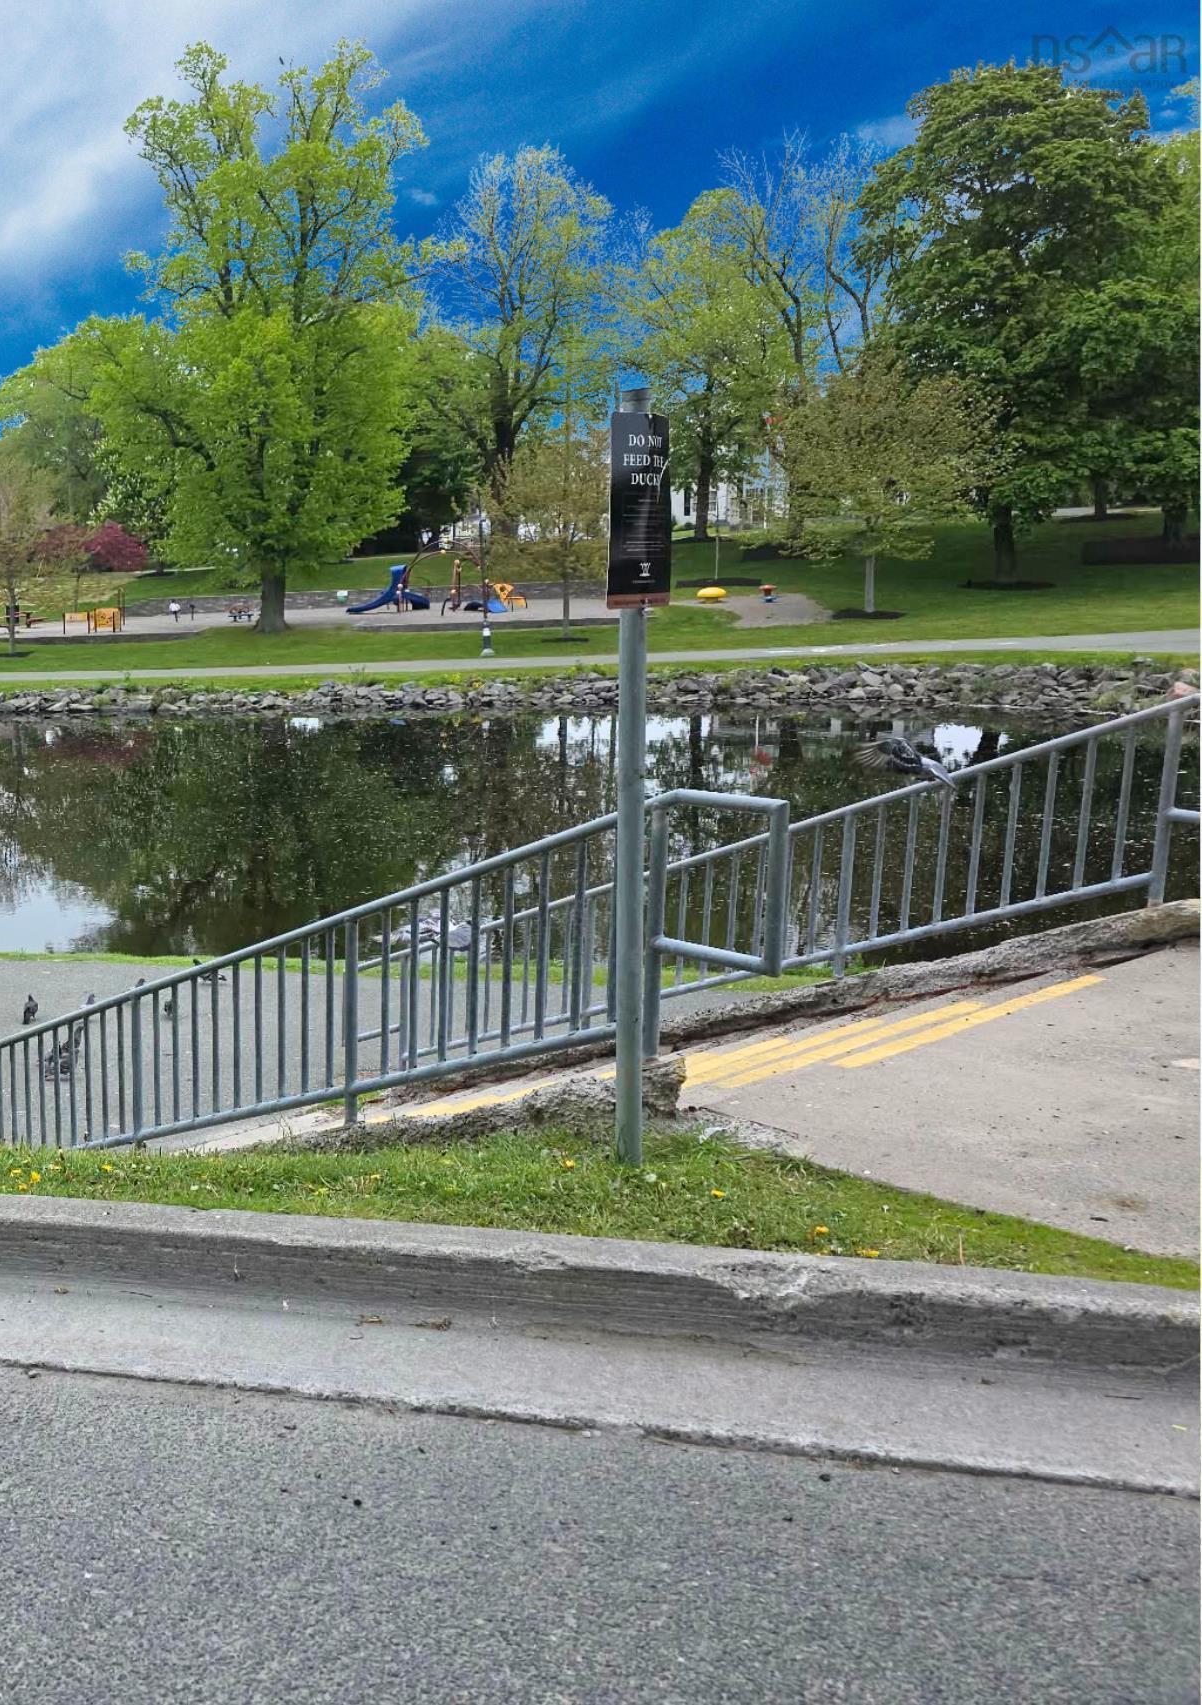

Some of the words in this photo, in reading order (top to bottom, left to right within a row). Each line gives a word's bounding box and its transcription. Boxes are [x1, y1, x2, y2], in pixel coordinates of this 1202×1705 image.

[628, 434, 645, 447] DO
[648, 435, 663, 448] NOT
[623, 454, 651, 466] FEED
